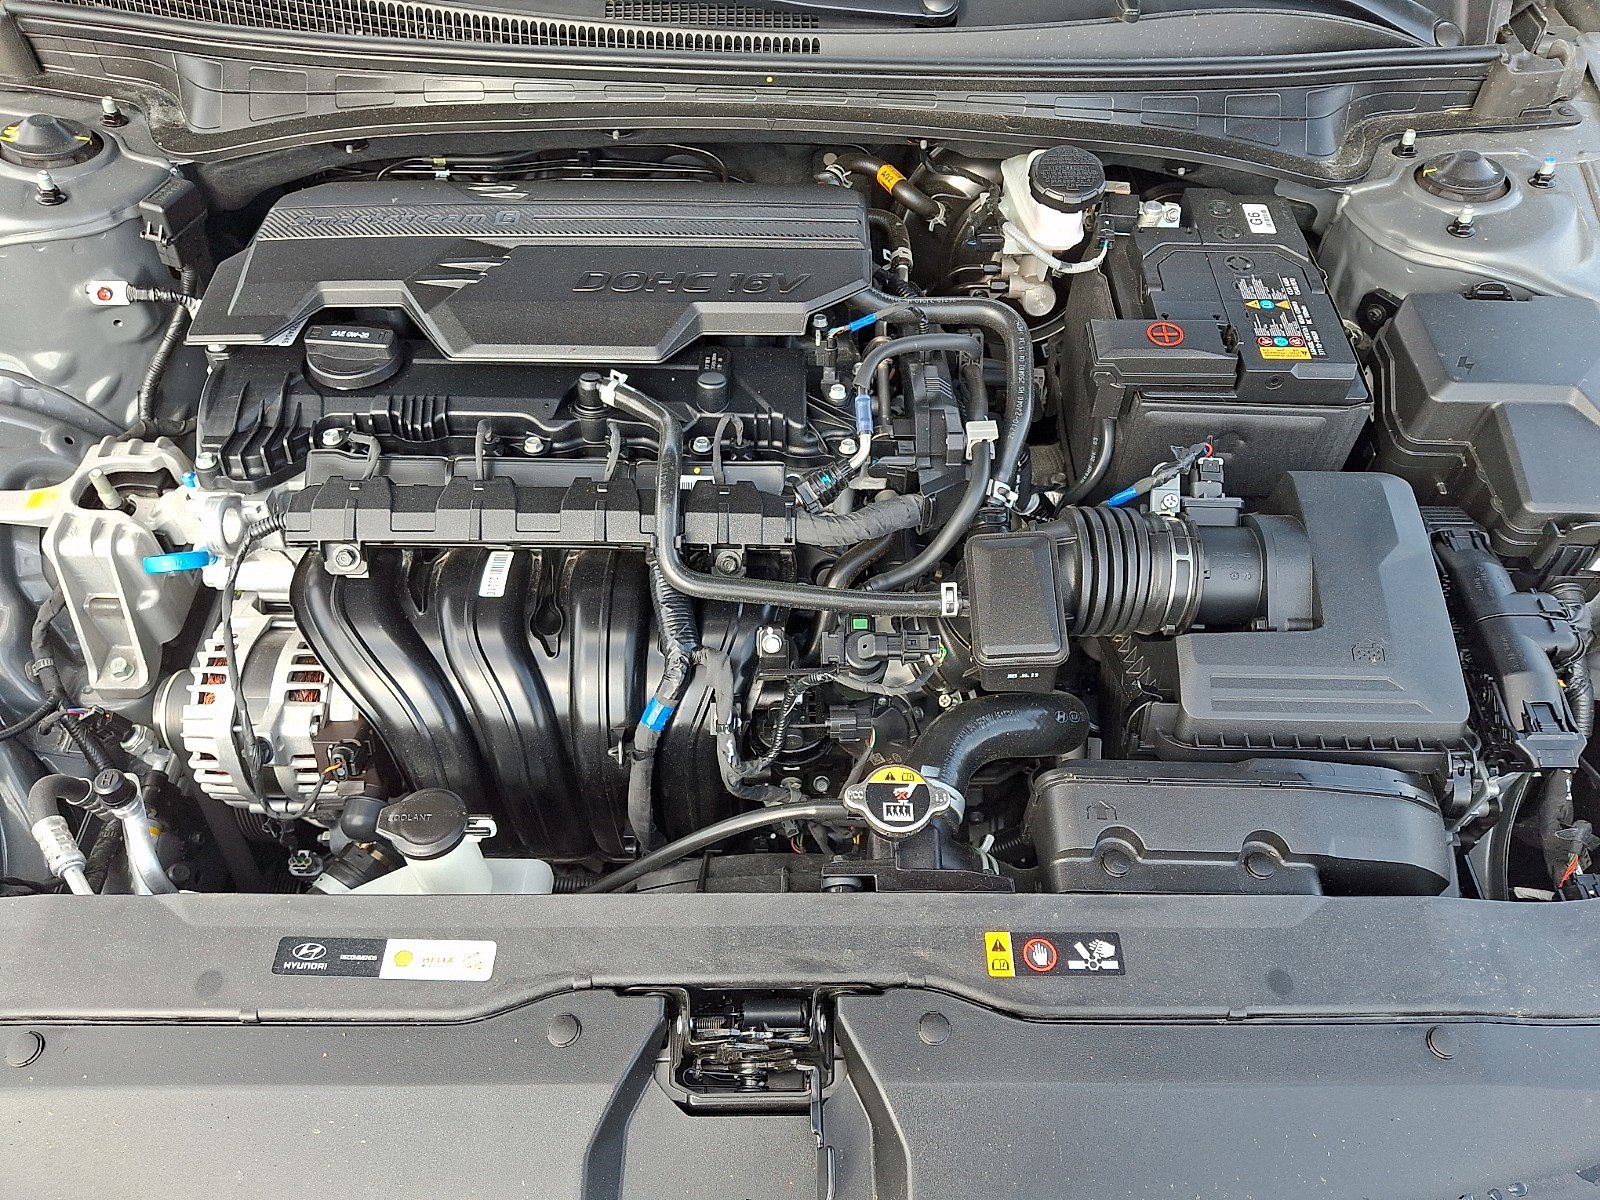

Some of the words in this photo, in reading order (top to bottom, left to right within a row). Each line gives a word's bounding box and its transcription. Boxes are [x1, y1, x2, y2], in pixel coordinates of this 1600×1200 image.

[288, 211, 486, 226] Smartstream
[1248, 212, 1263, 225] G6
[572, 271, 718, 293] DOHC
[728, 272, 812, 294] 16V
[346, 331, 370, 339] 0W-20
[388, 813, 433, 822] COOLANT
[284, 962, 327, 970] HYUNDAI
